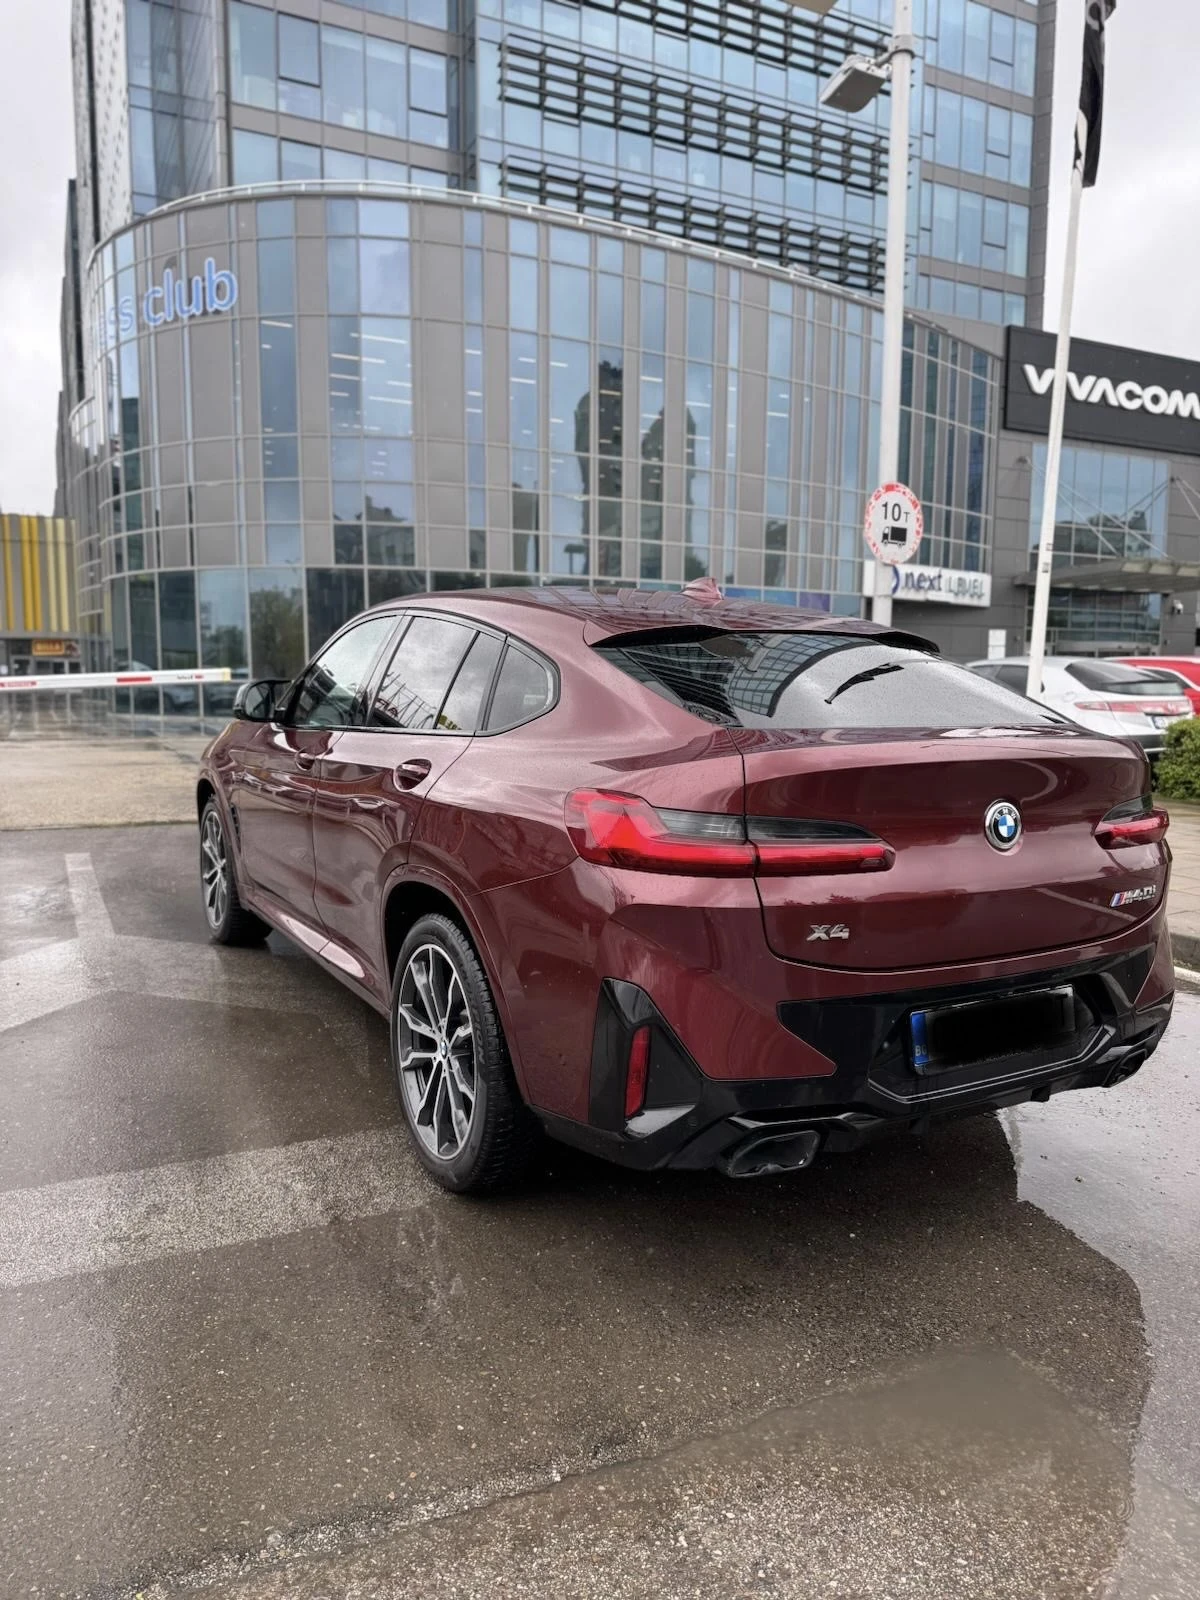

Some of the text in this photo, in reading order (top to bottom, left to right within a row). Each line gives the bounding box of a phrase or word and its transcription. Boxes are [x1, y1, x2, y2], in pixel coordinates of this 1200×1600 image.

[143, 257, 238, 326] club
[1023, 363, 1200, 421] VVACOM
[904, 570, 942, 592] next
[806, 923, 850, 941] X4
